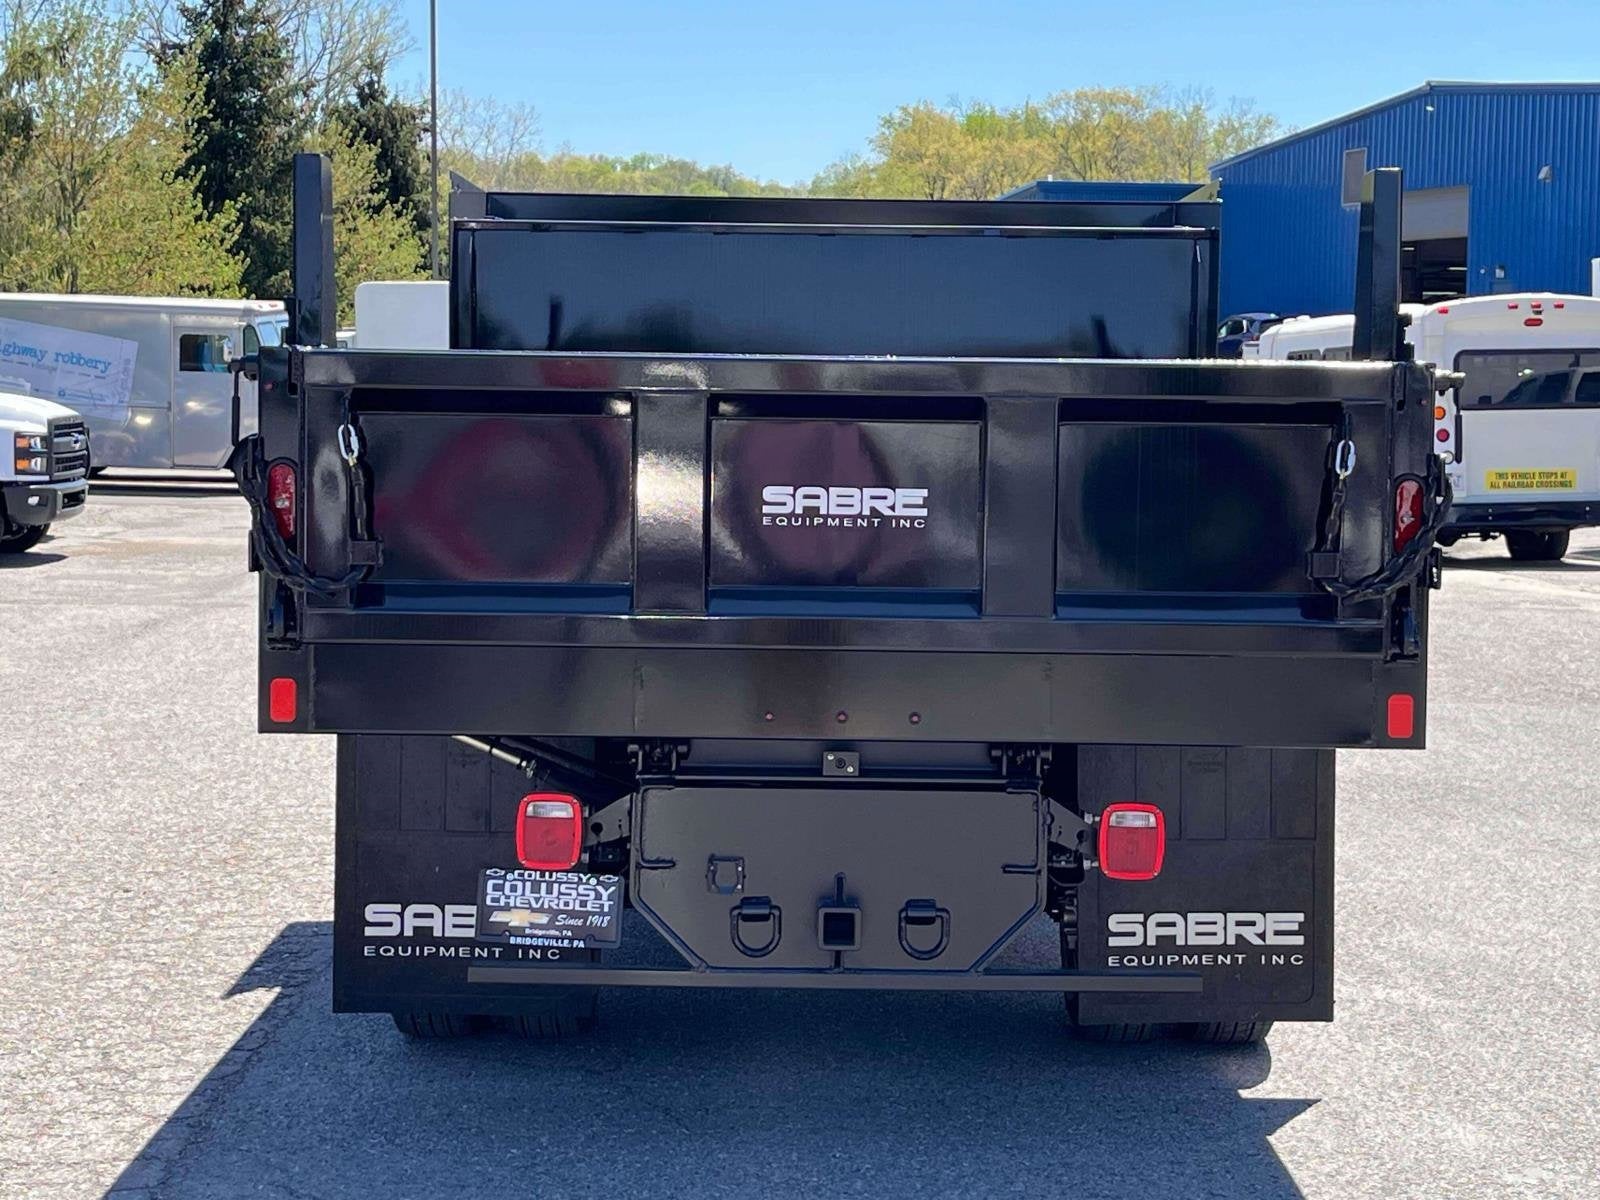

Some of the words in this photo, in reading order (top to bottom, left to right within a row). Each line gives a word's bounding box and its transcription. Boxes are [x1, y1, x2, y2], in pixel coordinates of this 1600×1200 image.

[54, 351, 111, 374] robbery
[1495, 472, 1508, 480] THIS
[1510, 472, 1536, 480] VEHICLE
[1538, 471, 1558, 480] STOPS
[1560, 471, 1568, 479] AT
[1490, 480, 1501, 489] ALL
[1502, 480, 1534, 489] RAILROAD
[1535, 480, 1573, 488] CROSSINGS
[762, 485, 928, 516] SABRE
[762, 516, 881, 528] EQUIPMENT
[892, 518, 926, 528] INC
[514, 870, 591, 883] COLUSSY
[486, 880, 616, 901] COLUSSY
[486, 894, 614, 912] CHEVROLET
[364, 903, 477, 938] SAB
[555, 914, 583, 927] Since
[586, 915, 611, 928] 1918
[1108, 912, 1305, 946] SABRE
[573, 940, 585, 948] PA
[364, 945, 504, 960] EQUIPMENT
[518, 948, 561, 960] INC
[1108, 954, 1247, 967] EQUIPMENT
[1261, 954, 1304, 966] INC
